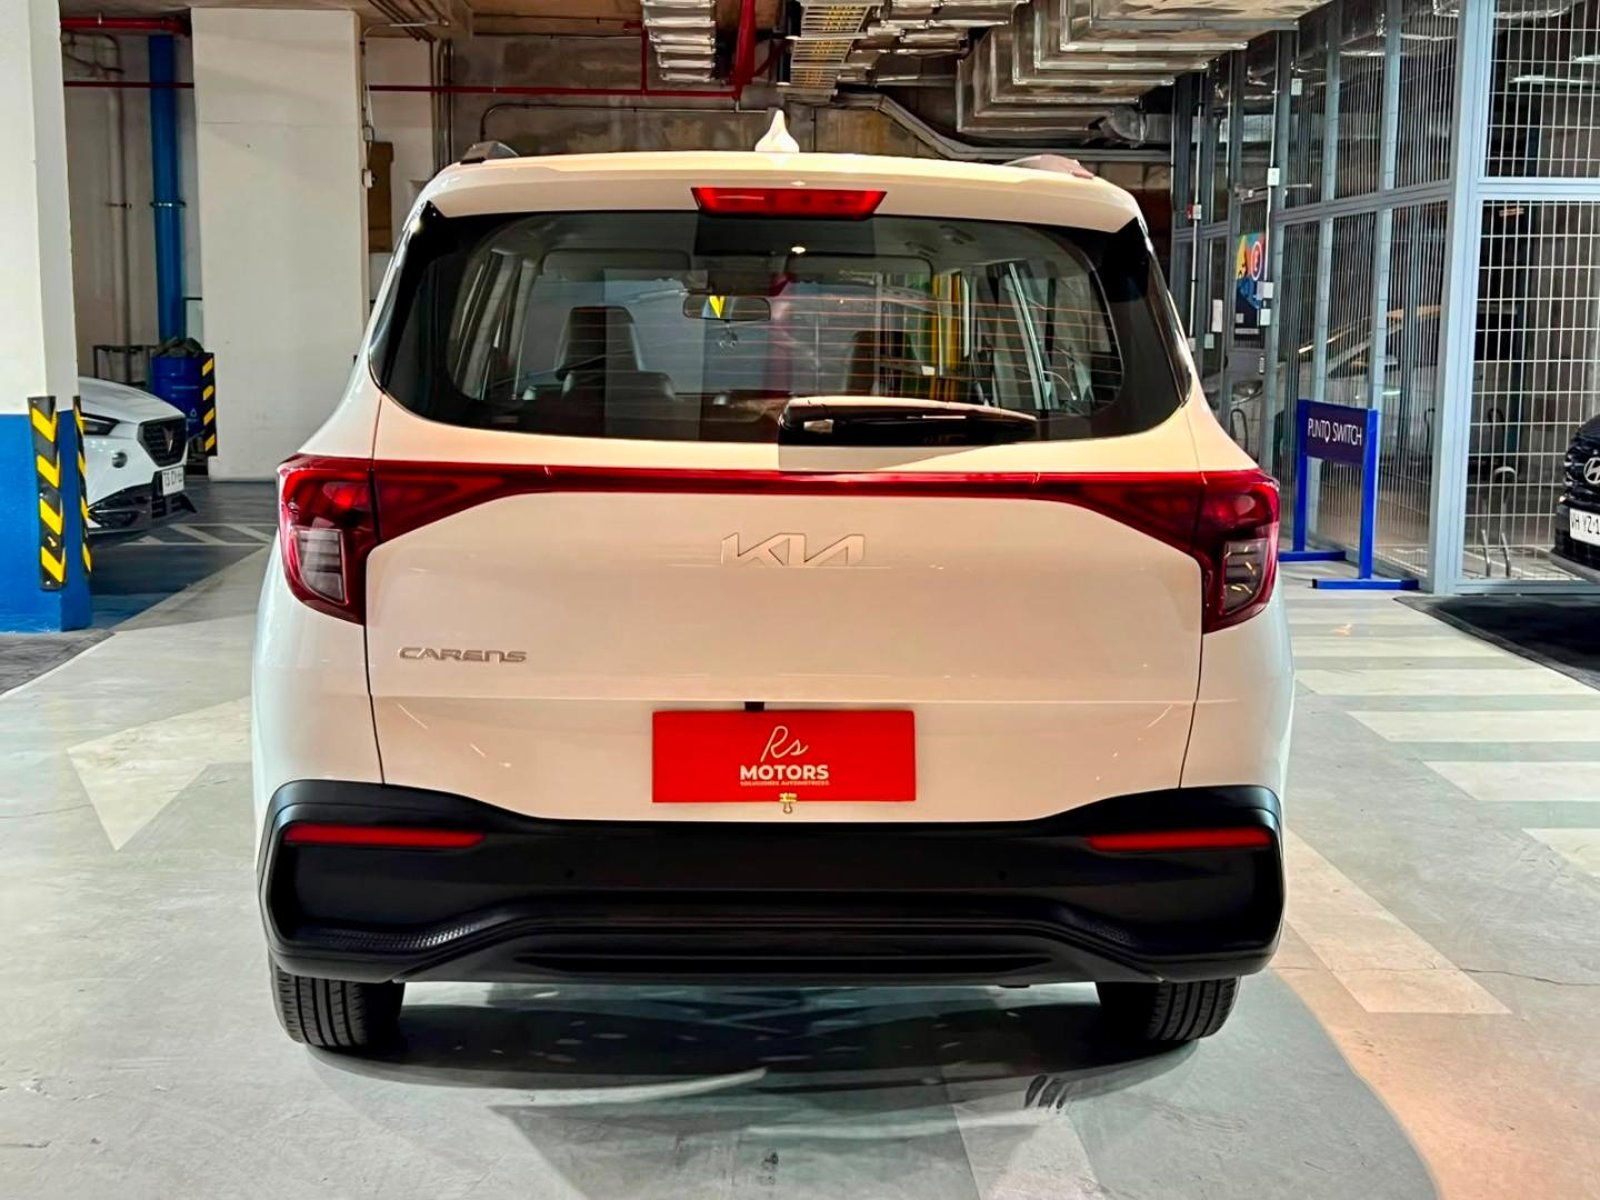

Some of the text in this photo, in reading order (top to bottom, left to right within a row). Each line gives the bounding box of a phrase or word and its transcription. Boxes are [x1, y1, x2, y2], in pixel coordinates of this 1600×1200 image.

[1308, 418, 1362, 446] PUNTO SWITCH
[720, 532, 865, 567] KIA
[399, 646, 527, 662] CARENS
[759, 725, 809, 762] Rs
[739, 764, 830, 780] MOTORS
